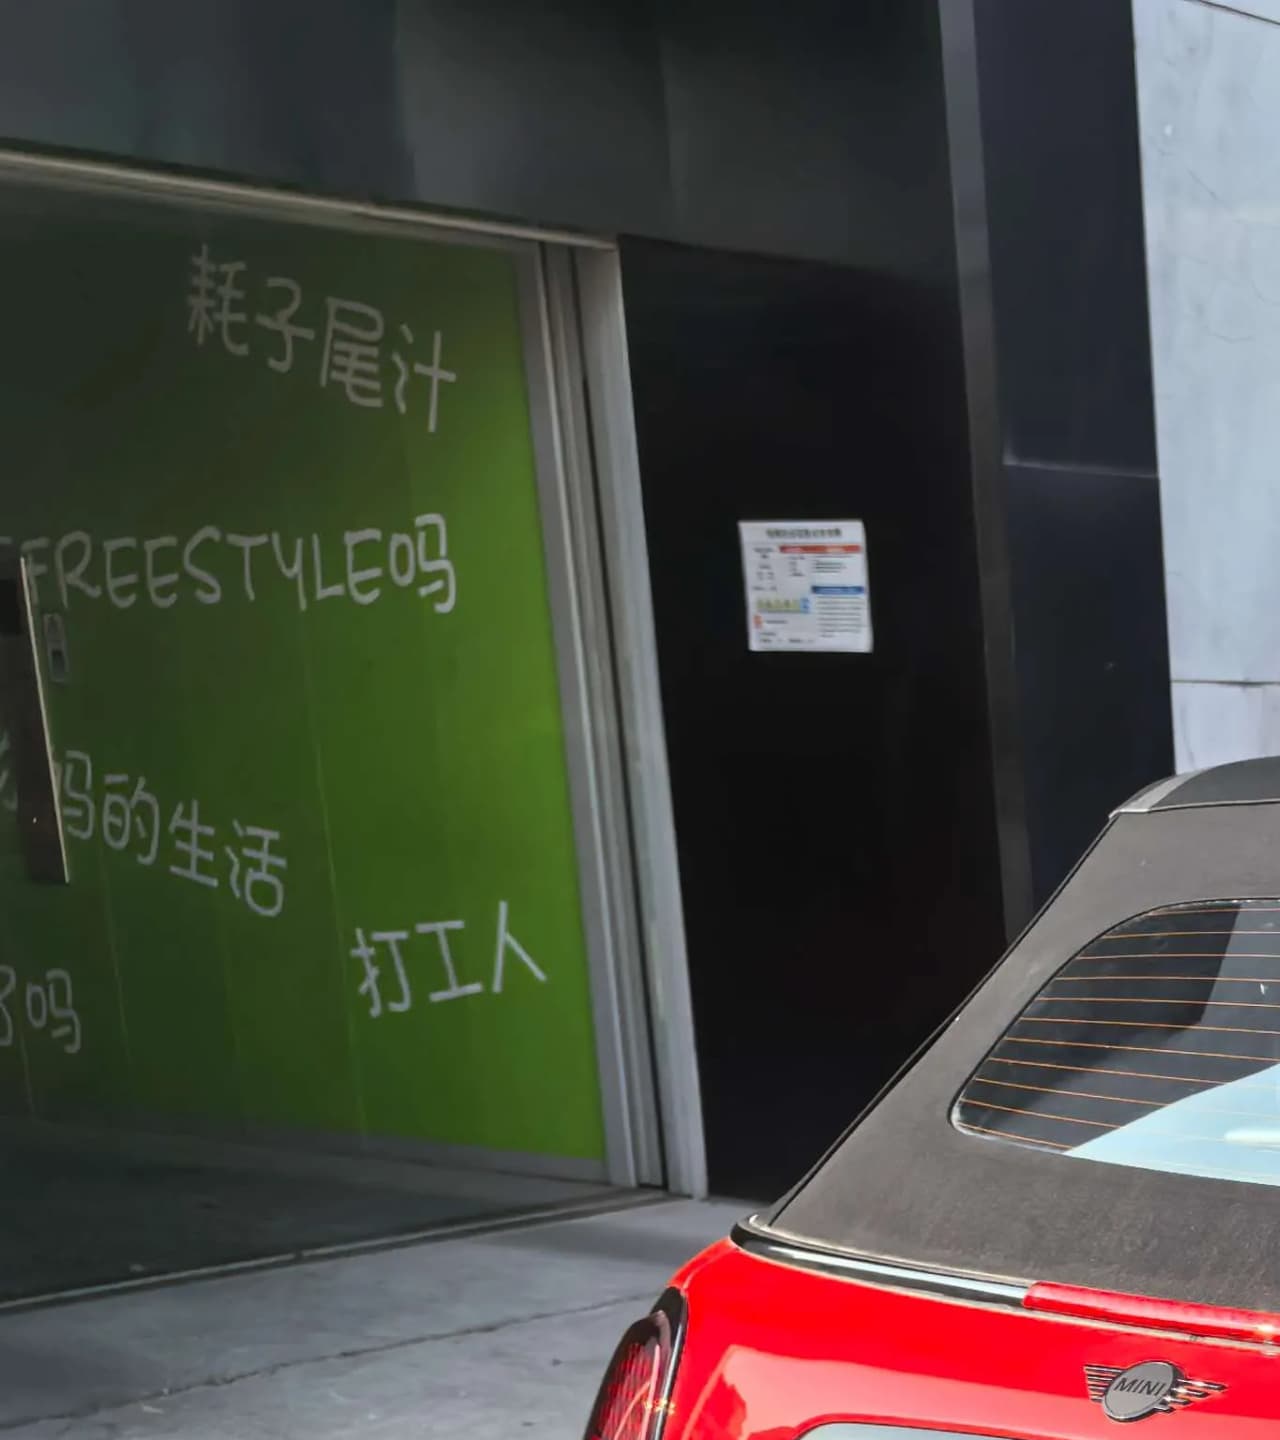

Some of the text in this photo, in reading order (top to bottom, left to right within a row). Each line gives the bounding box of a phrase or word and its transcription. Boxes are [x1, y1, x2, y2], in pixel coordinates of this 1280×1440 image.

[187, 245, 456, 433] 耗子尾汁
[350, 900, 546, 1018] 打工人
[1113, 1377, 1168, 1398] MINI
